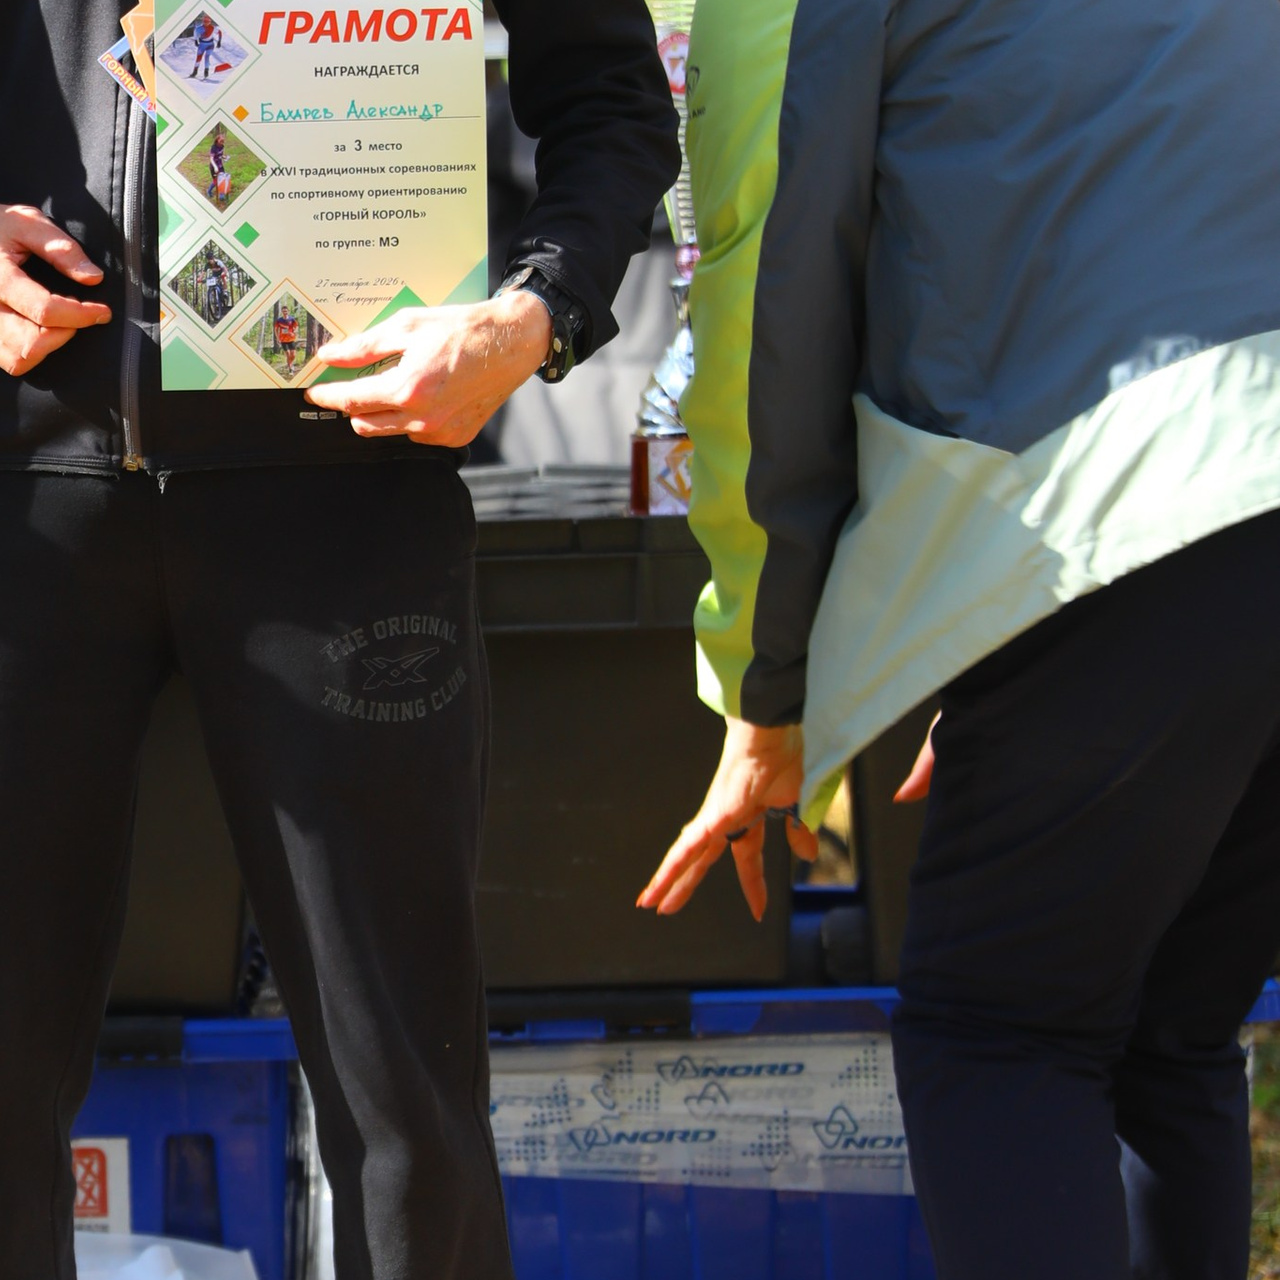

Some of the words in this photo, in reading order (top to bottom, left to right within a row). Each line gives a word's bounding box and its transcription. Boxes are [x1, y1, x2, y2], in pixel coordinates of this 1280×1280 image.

[258, 7, 473, 45] ГРАМОТА
[101, 52, 150, 104] ГОРНЫЙ
[314, 63, 420, 79] НАГРАЖДАЕТСЯ
[334, 143, 346, 152] за
[354, 139, 363, 152] 3
[368, 142, 403, 152] место
[260, 168, 267, 177] в
[270, 166, 297, 177] XXVI
[299, 165, 386, 181] традиционных
[388, 163, 477, 177] соревнованиях
[271, 190, 285, 200] по
[288, 188, 365, 202] спортивному
[367, 185, 468, 199] ориентированию
[312, 207, 369, 222] «ГОРНЫЙ
[372, 208, 427, 220] КОРОЛЬ»
[315, 239, 330, 249] по
[332, 237, 376, 251] группе:
[379, 236, 400, 247] МЭ
[315, 278, 329, 288] 27
[320, 627, 368, 662] THE
[372, 614, 458, 645] ORIGINAL
[320, 686, 427, 722] TRAINING
[430, 666, 468, 712] CLUB
[700, 1062, 805, 1077] NORD
[612, 1129, 717, 1144] NORD
